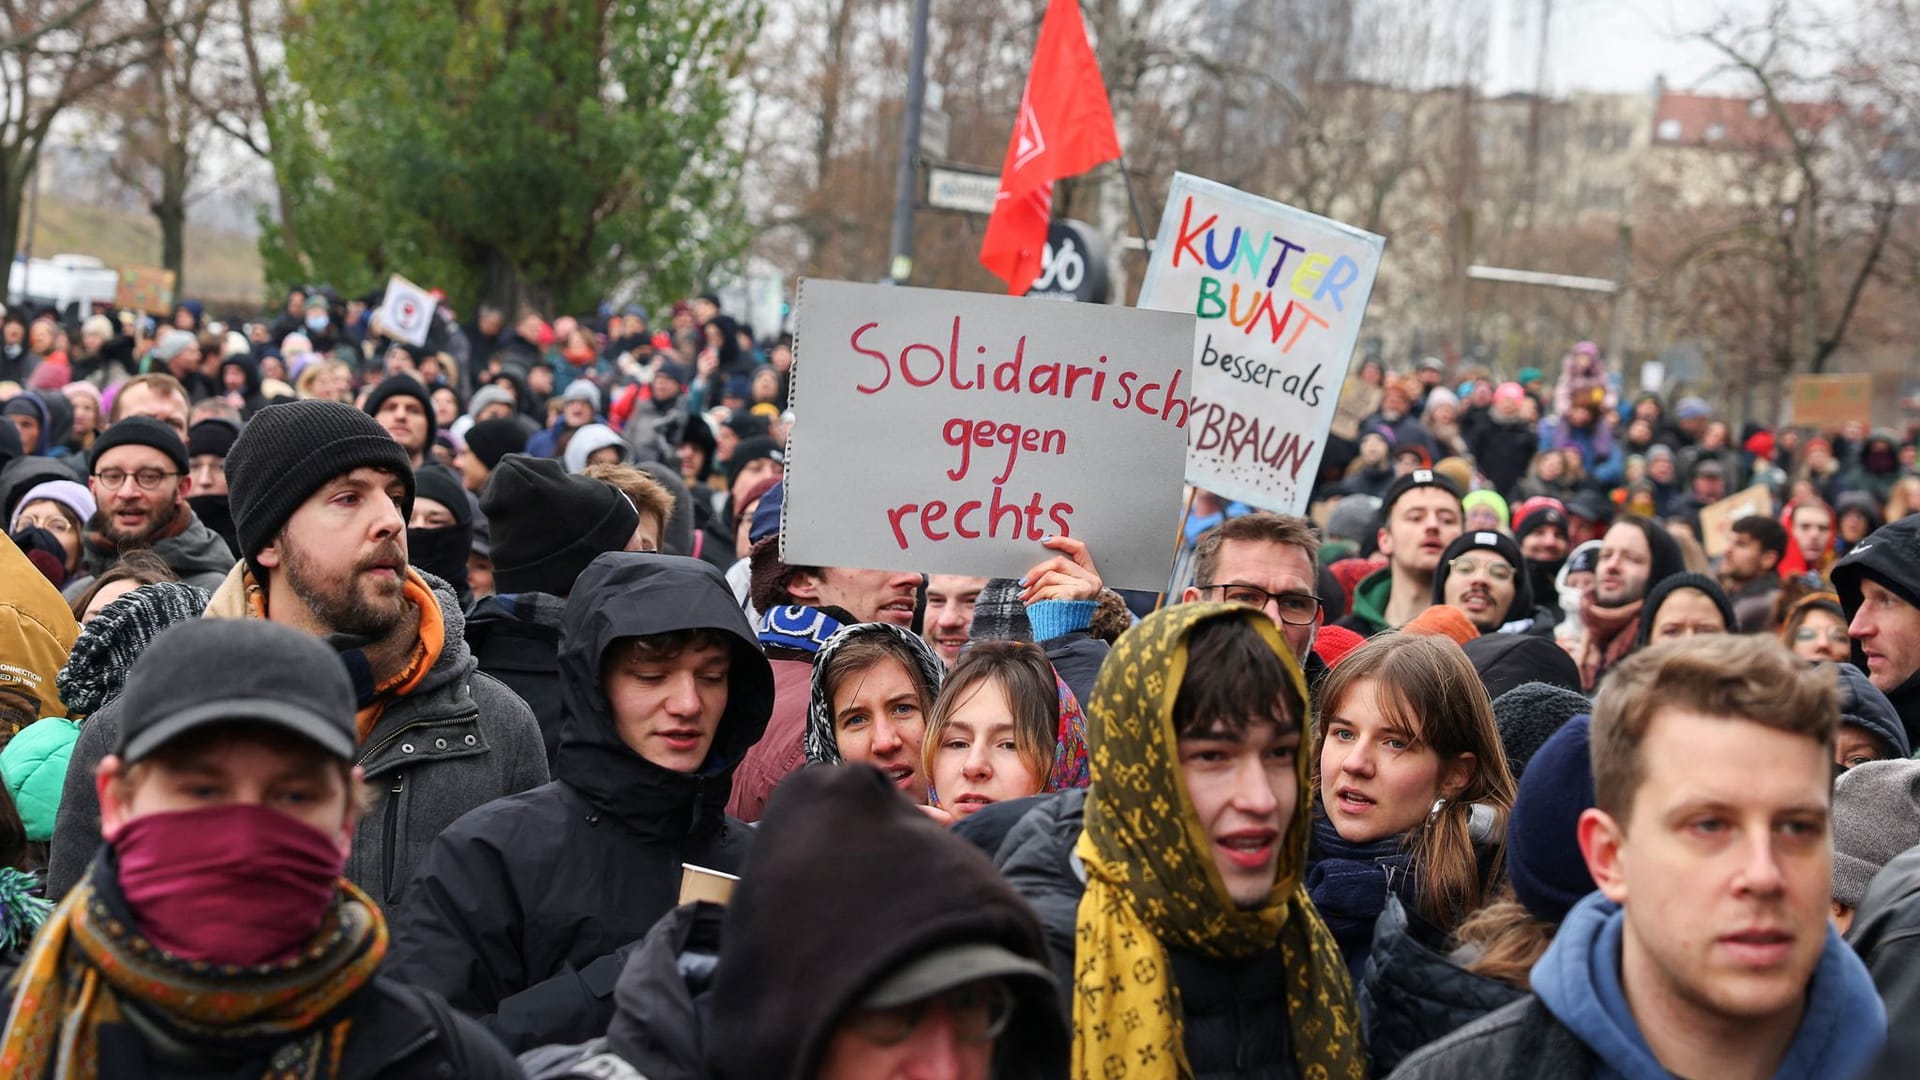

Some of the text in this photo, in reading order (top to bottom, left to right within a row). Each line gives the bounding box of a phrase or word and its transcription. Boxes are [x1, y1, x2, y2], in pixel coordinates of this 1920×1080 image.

[1171, 196, 1359, 312] KUNTER
[1196, 276, 1330, 354] BUNT
[850, 315, 1189, 429] Solidarisch
[1200, 333, 1325, 407] besser als
[942, 418, 1067, 486] gegen
[887, 486, 1074, 550] rechts
